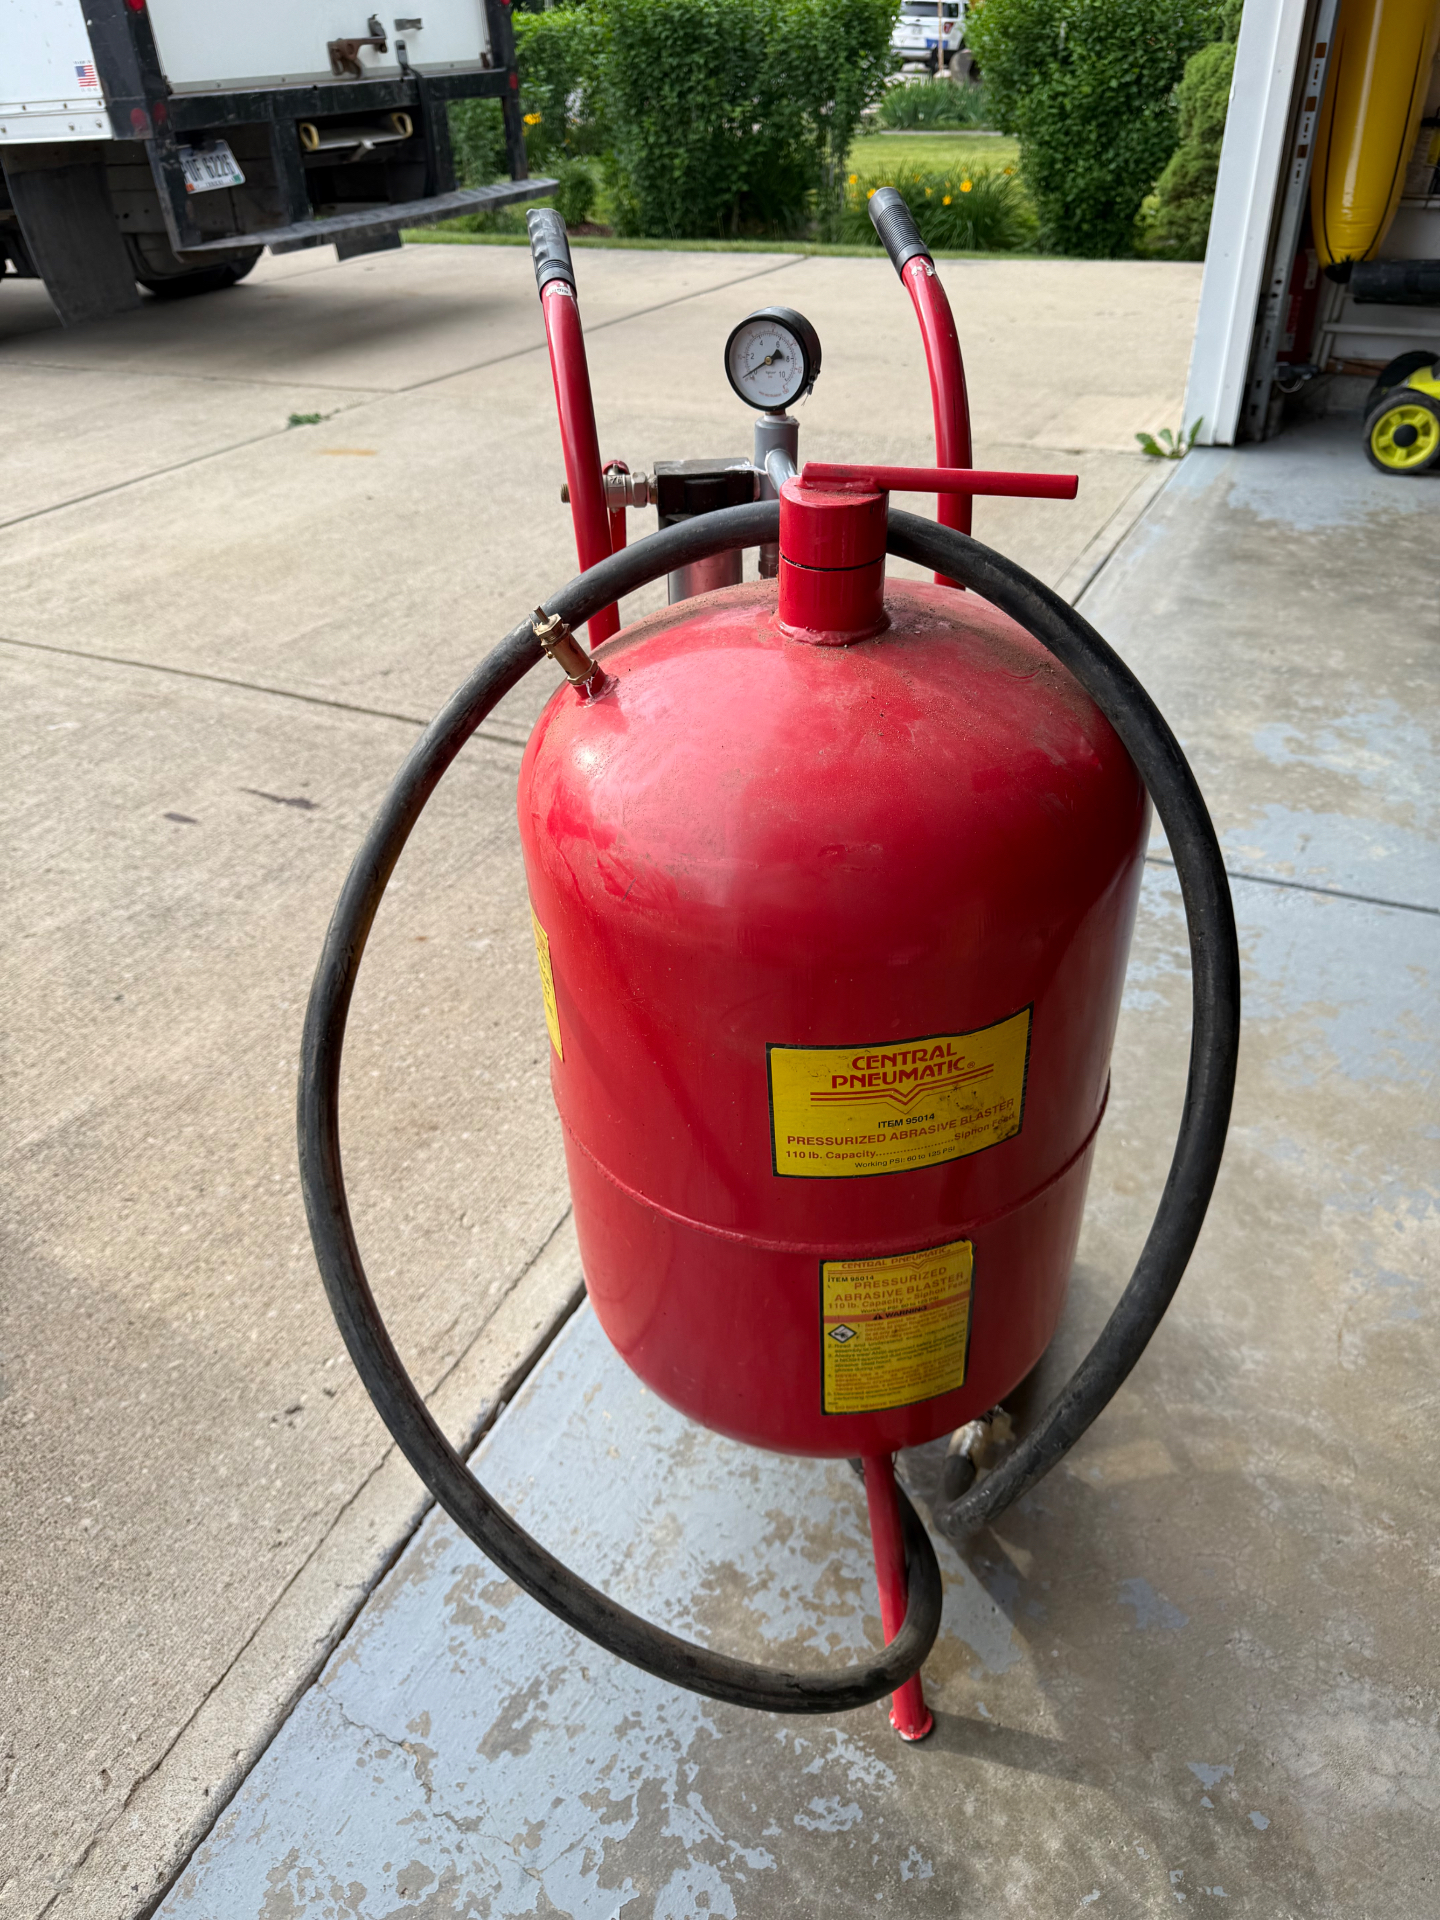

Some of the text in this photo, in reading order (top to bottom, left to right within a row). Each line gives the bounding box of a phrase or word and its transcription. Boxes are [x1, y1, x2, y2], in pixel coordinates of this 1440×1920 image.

[779, 370, 785, 378] 10
[852, 1043, 957, 1071] CENTRAL
[787, 1098, 1014, 1145] PRESSURIZED ABRASIVE BLASTER
[877, 1113, 935, 1129] ITEM 95014
[786, 1150, 806, 1159] 110
[808, 1150, 823, 1159] lb.
[954, 1124, 990, 1142] Siphon
[854, 1160, 888, 1168] Working
[889, 1157, 905, 1166] PSI:
[907, 1154, 916, 1162] 60
[928, 1150, 942, 1158] 125
[943, 1146, 955, 1155] PSI
[842, 1247, 948, 1269] CENTRAL PNEUMATIC
[827, 1275, 848, 1283] ITEM
[834, 1272, 964, 1302] ABRASIVE BLASTER
[854, 1267, 947, 1290] PRESSURIZED
[862, 1297, 903, 1308] Capacity
[914, 1287, 946, 1301] Siphon
[885, 1305, 928, 1318] WARNING
